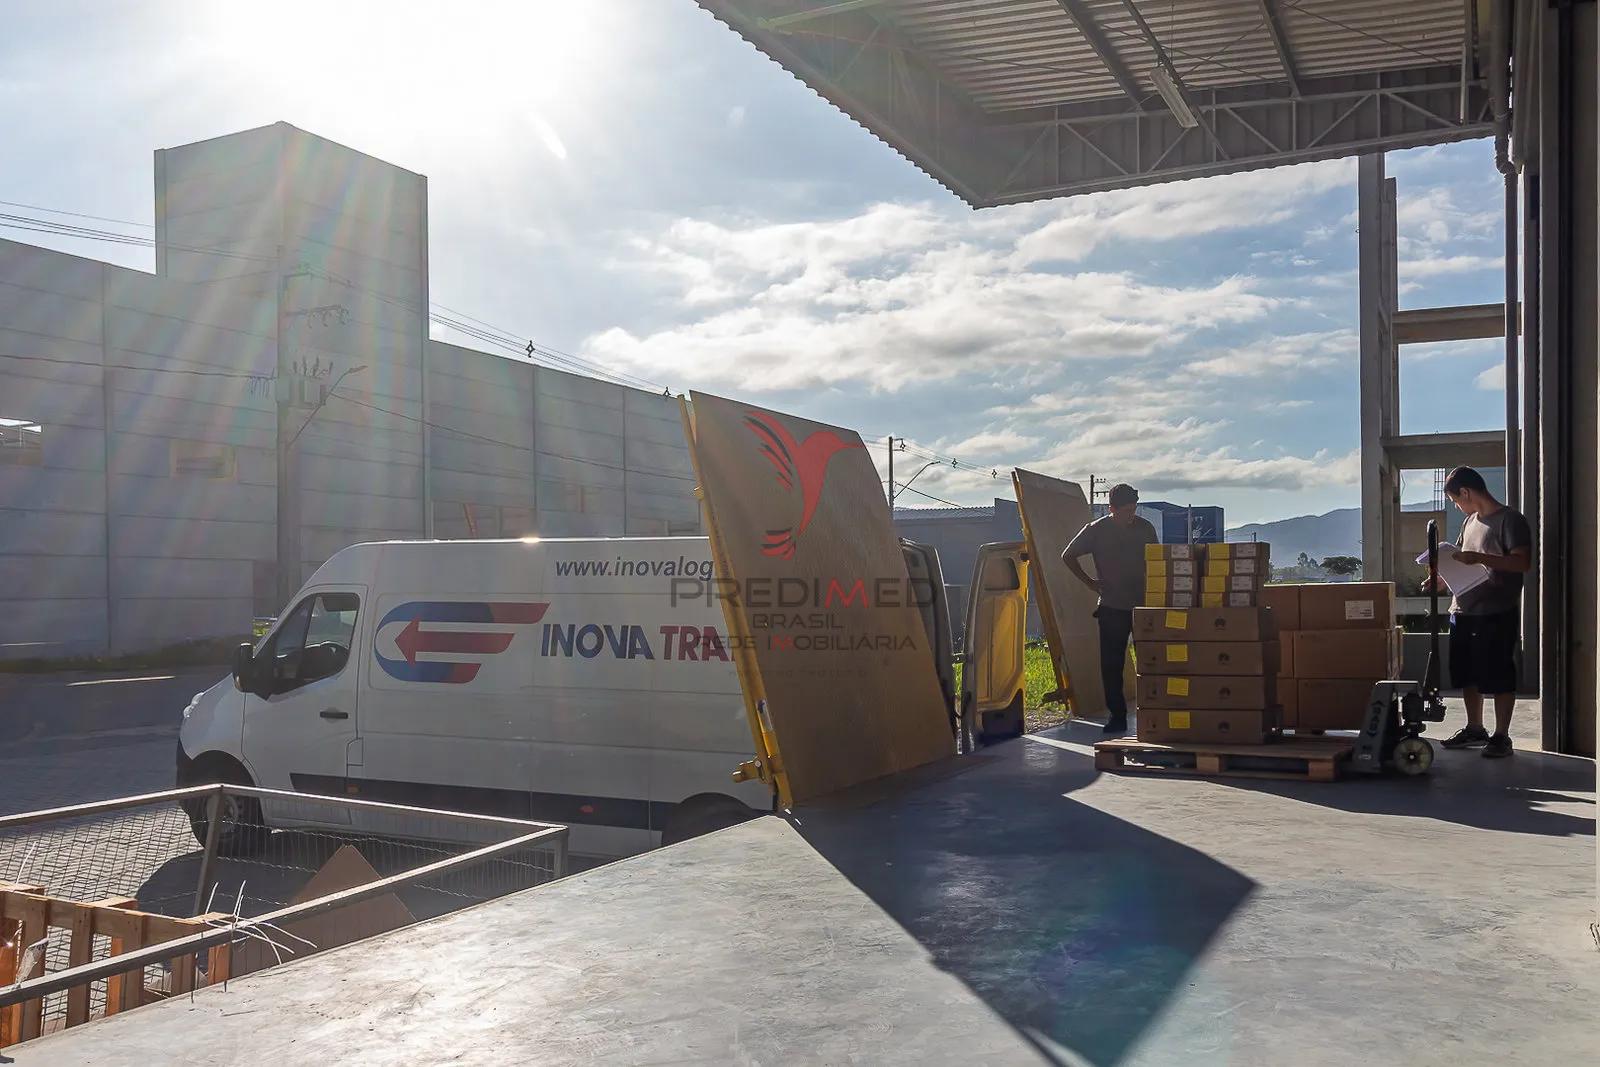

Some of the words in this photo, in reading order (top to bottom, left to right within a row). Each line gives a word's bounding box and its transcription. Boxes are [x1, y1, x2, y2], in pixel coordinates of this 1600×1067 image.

[555, 556, 714, 581] www.inovalog
[541, 623, 655, 659] INOVA
[660, 625, 736, 662] TRA
